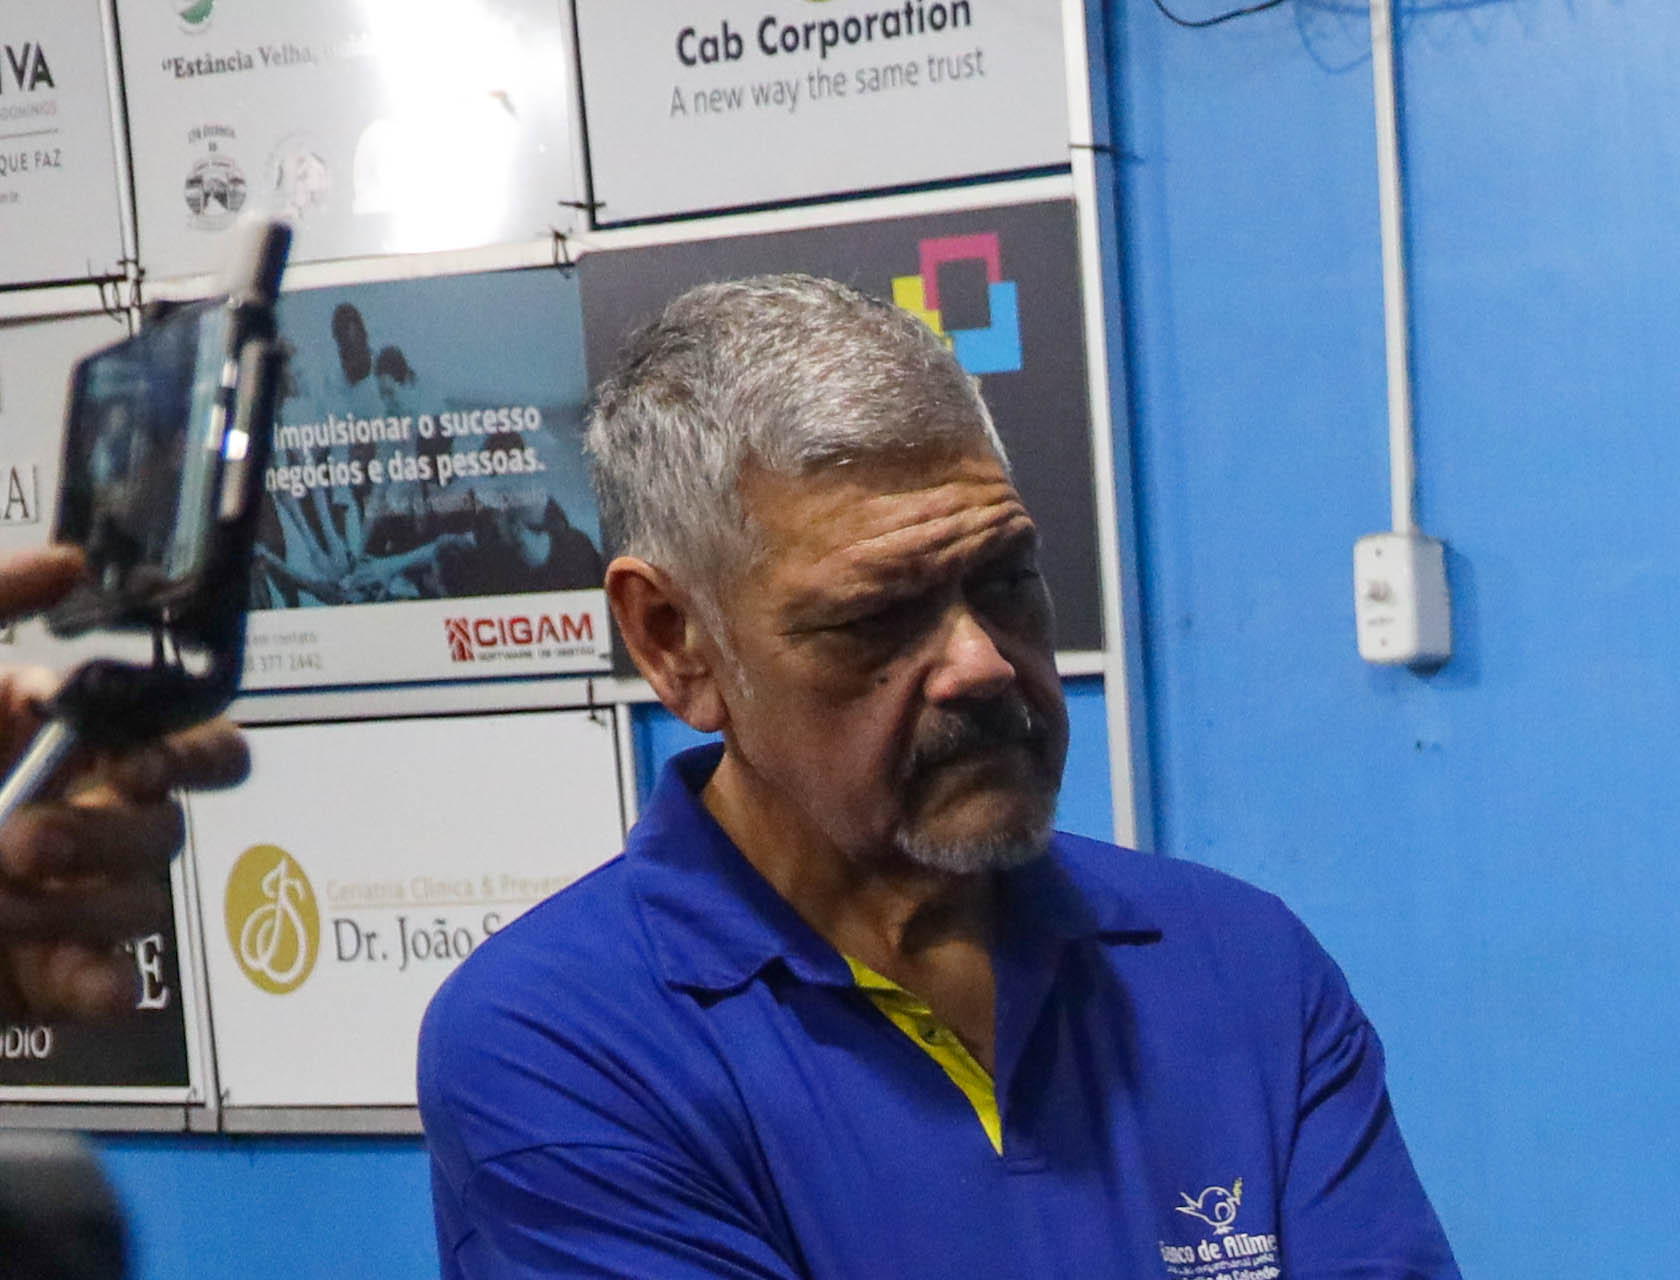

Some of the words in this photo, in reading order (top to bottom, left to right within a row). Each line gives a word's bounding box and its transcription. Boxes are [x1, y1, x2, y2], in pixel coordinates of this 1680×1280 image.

[676, 22, 744, 66] Cab
[757, 0, 972, 58] Corporation
[669, 86, 687, 118] A
[693, 82, 743, 114] new
[751, 77, 799, 114] way
[807, 67, 848, 101] the
[854, 58, 920, 95] same
[927, 46, 986, 83] trust
[35, 148, 62, 168] FAZ
[419, 416, 435, 439] o
[440, 405, 542, 439] sucesso
[265, 457, 364, 498] negócios
[367, 460, 384, 484] e
[387, 450, 432, 483] das
[437, 444, 547, 486] pessoas.
[472, 612, 594, 648] CIGAM
[332, 918, 389, 962] Dr.
[397, 916, 474, 971] João
[1197, 1239, 1222, 1262] de
